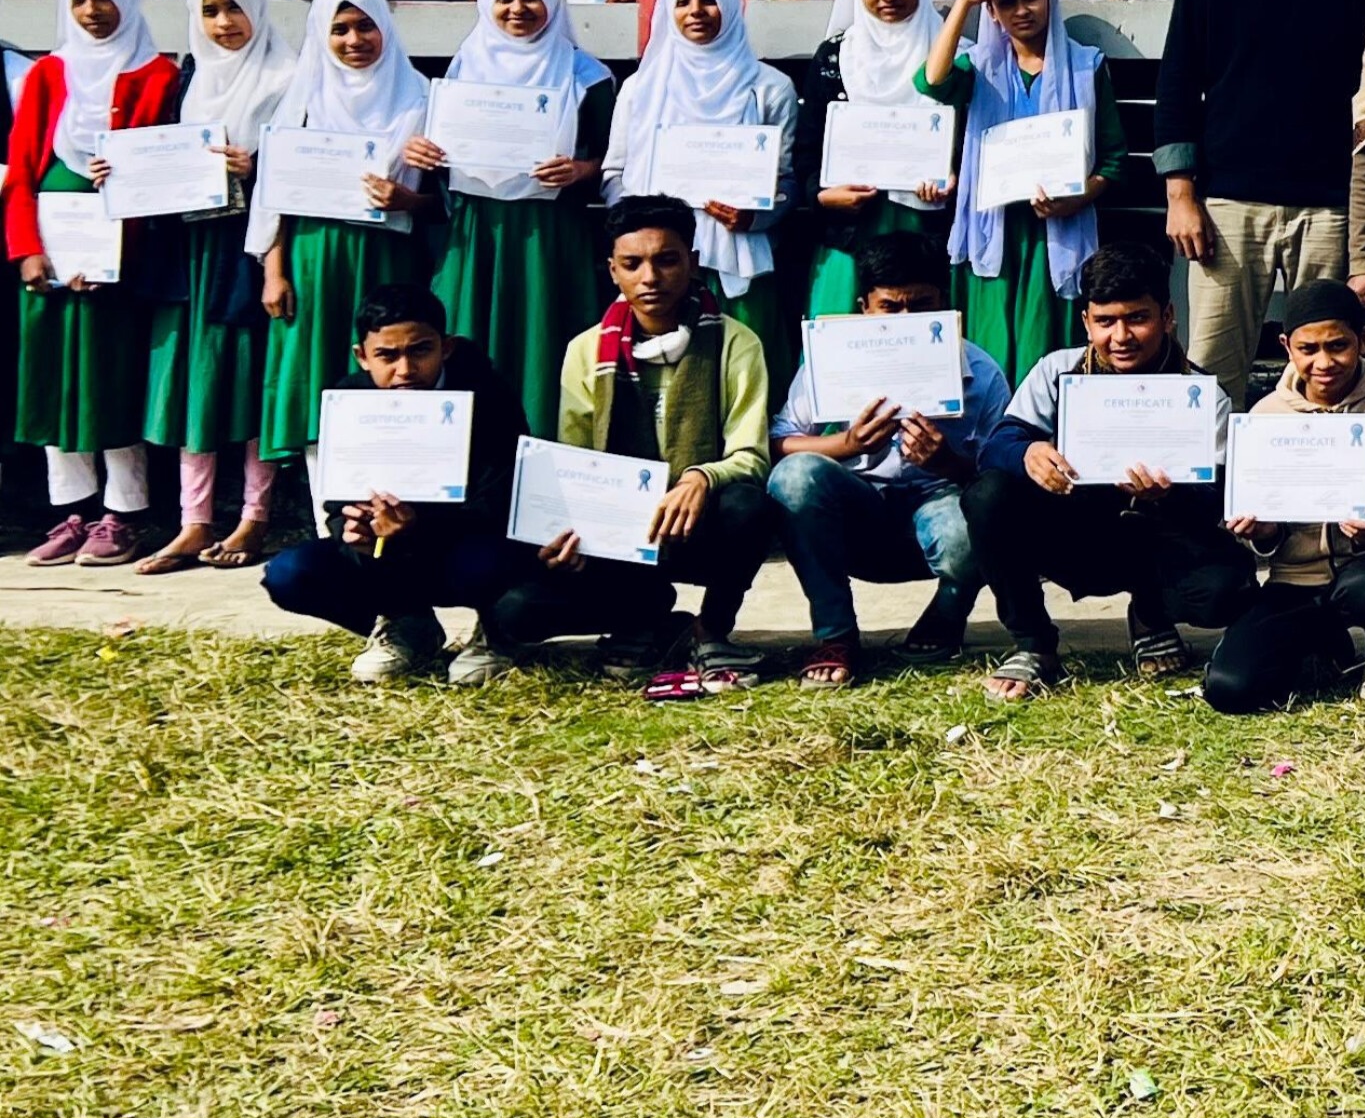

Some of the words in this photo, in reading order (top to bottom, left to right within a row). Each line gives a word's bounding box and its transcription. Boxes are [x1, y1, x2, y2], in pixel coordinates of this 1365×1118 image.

[846, 335, 916, 350] CERTIFICATE
[1103, 398, 1173, 409] CERTIFICATE
[1270, 436, 1336, 447] CERTIFICATE
